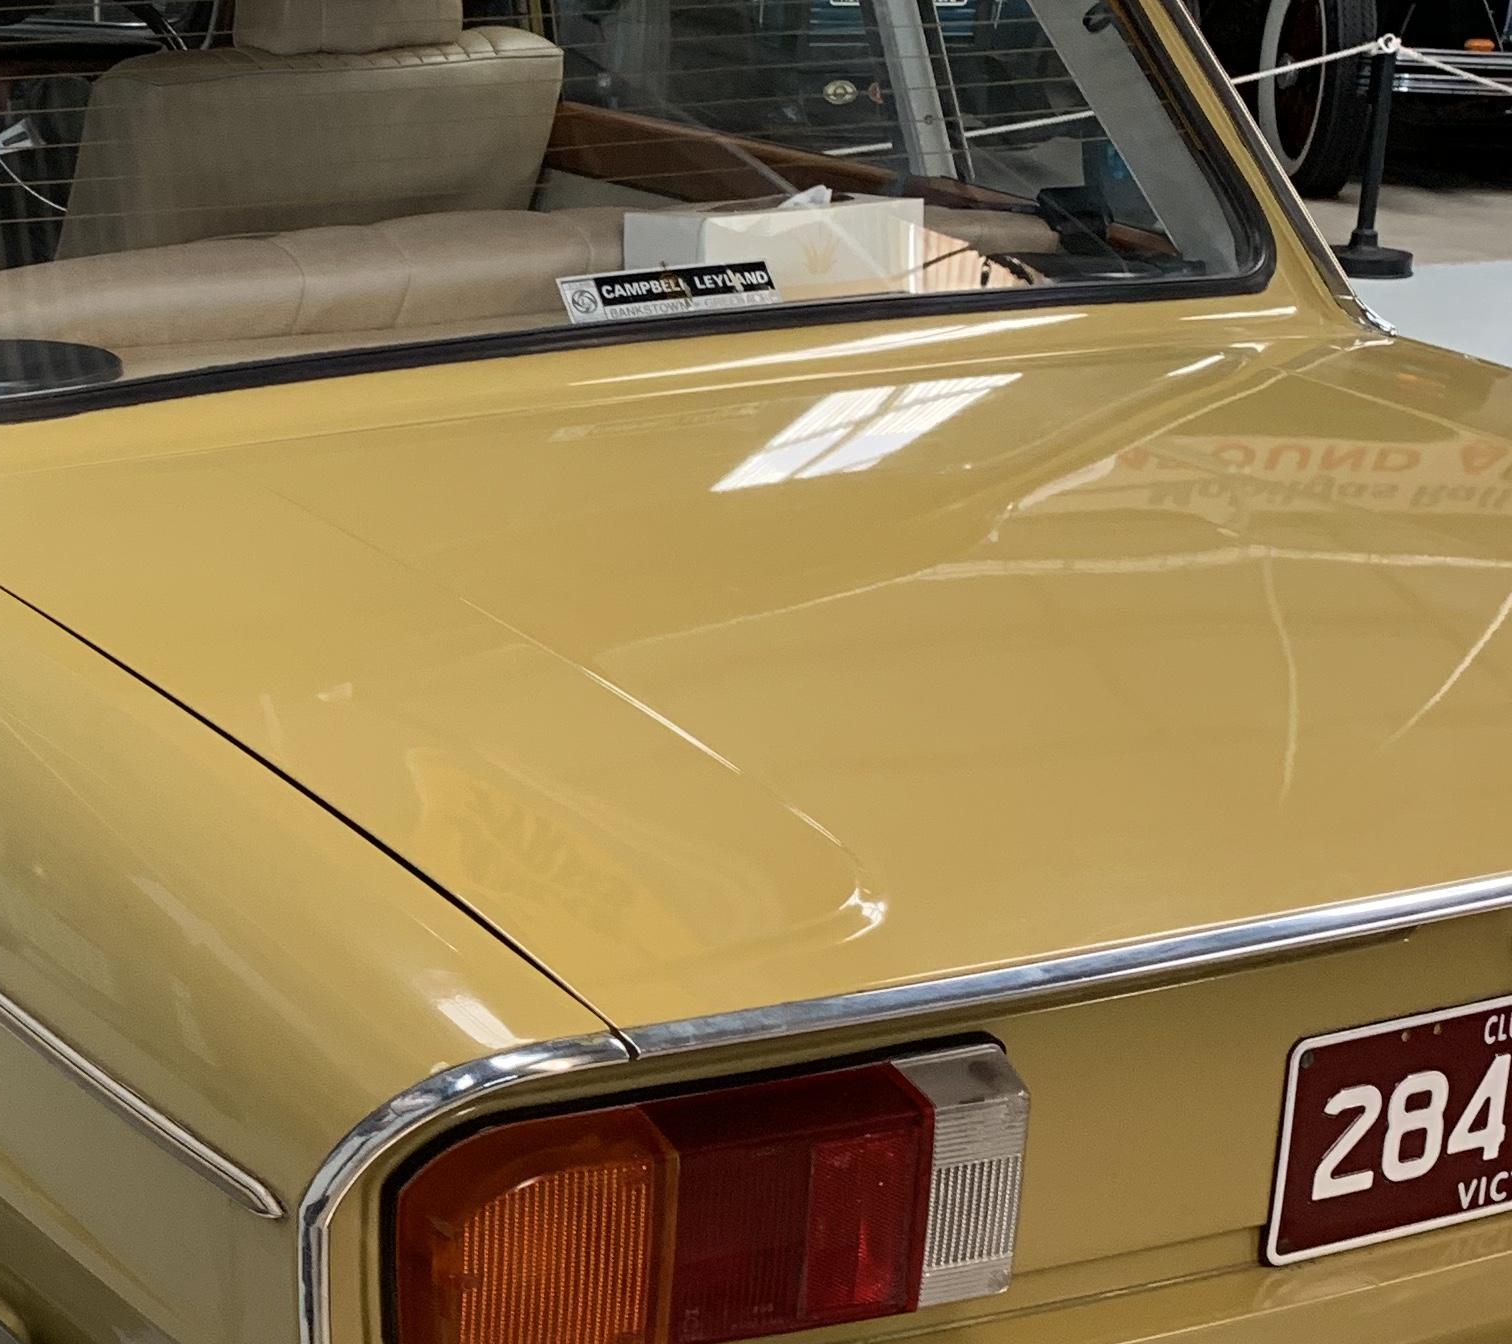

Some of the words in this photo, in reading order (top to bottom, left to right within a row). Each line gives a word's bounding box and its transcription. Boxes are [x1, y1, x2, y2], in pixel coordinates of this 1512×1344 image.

[693, 270, 769, 289] LEYLAND
[1484, 1011, 1512, 1045] CL
[1312, 1053, 1511, 1201] 284
[1458, 1170, 1512, 1209] VIC
